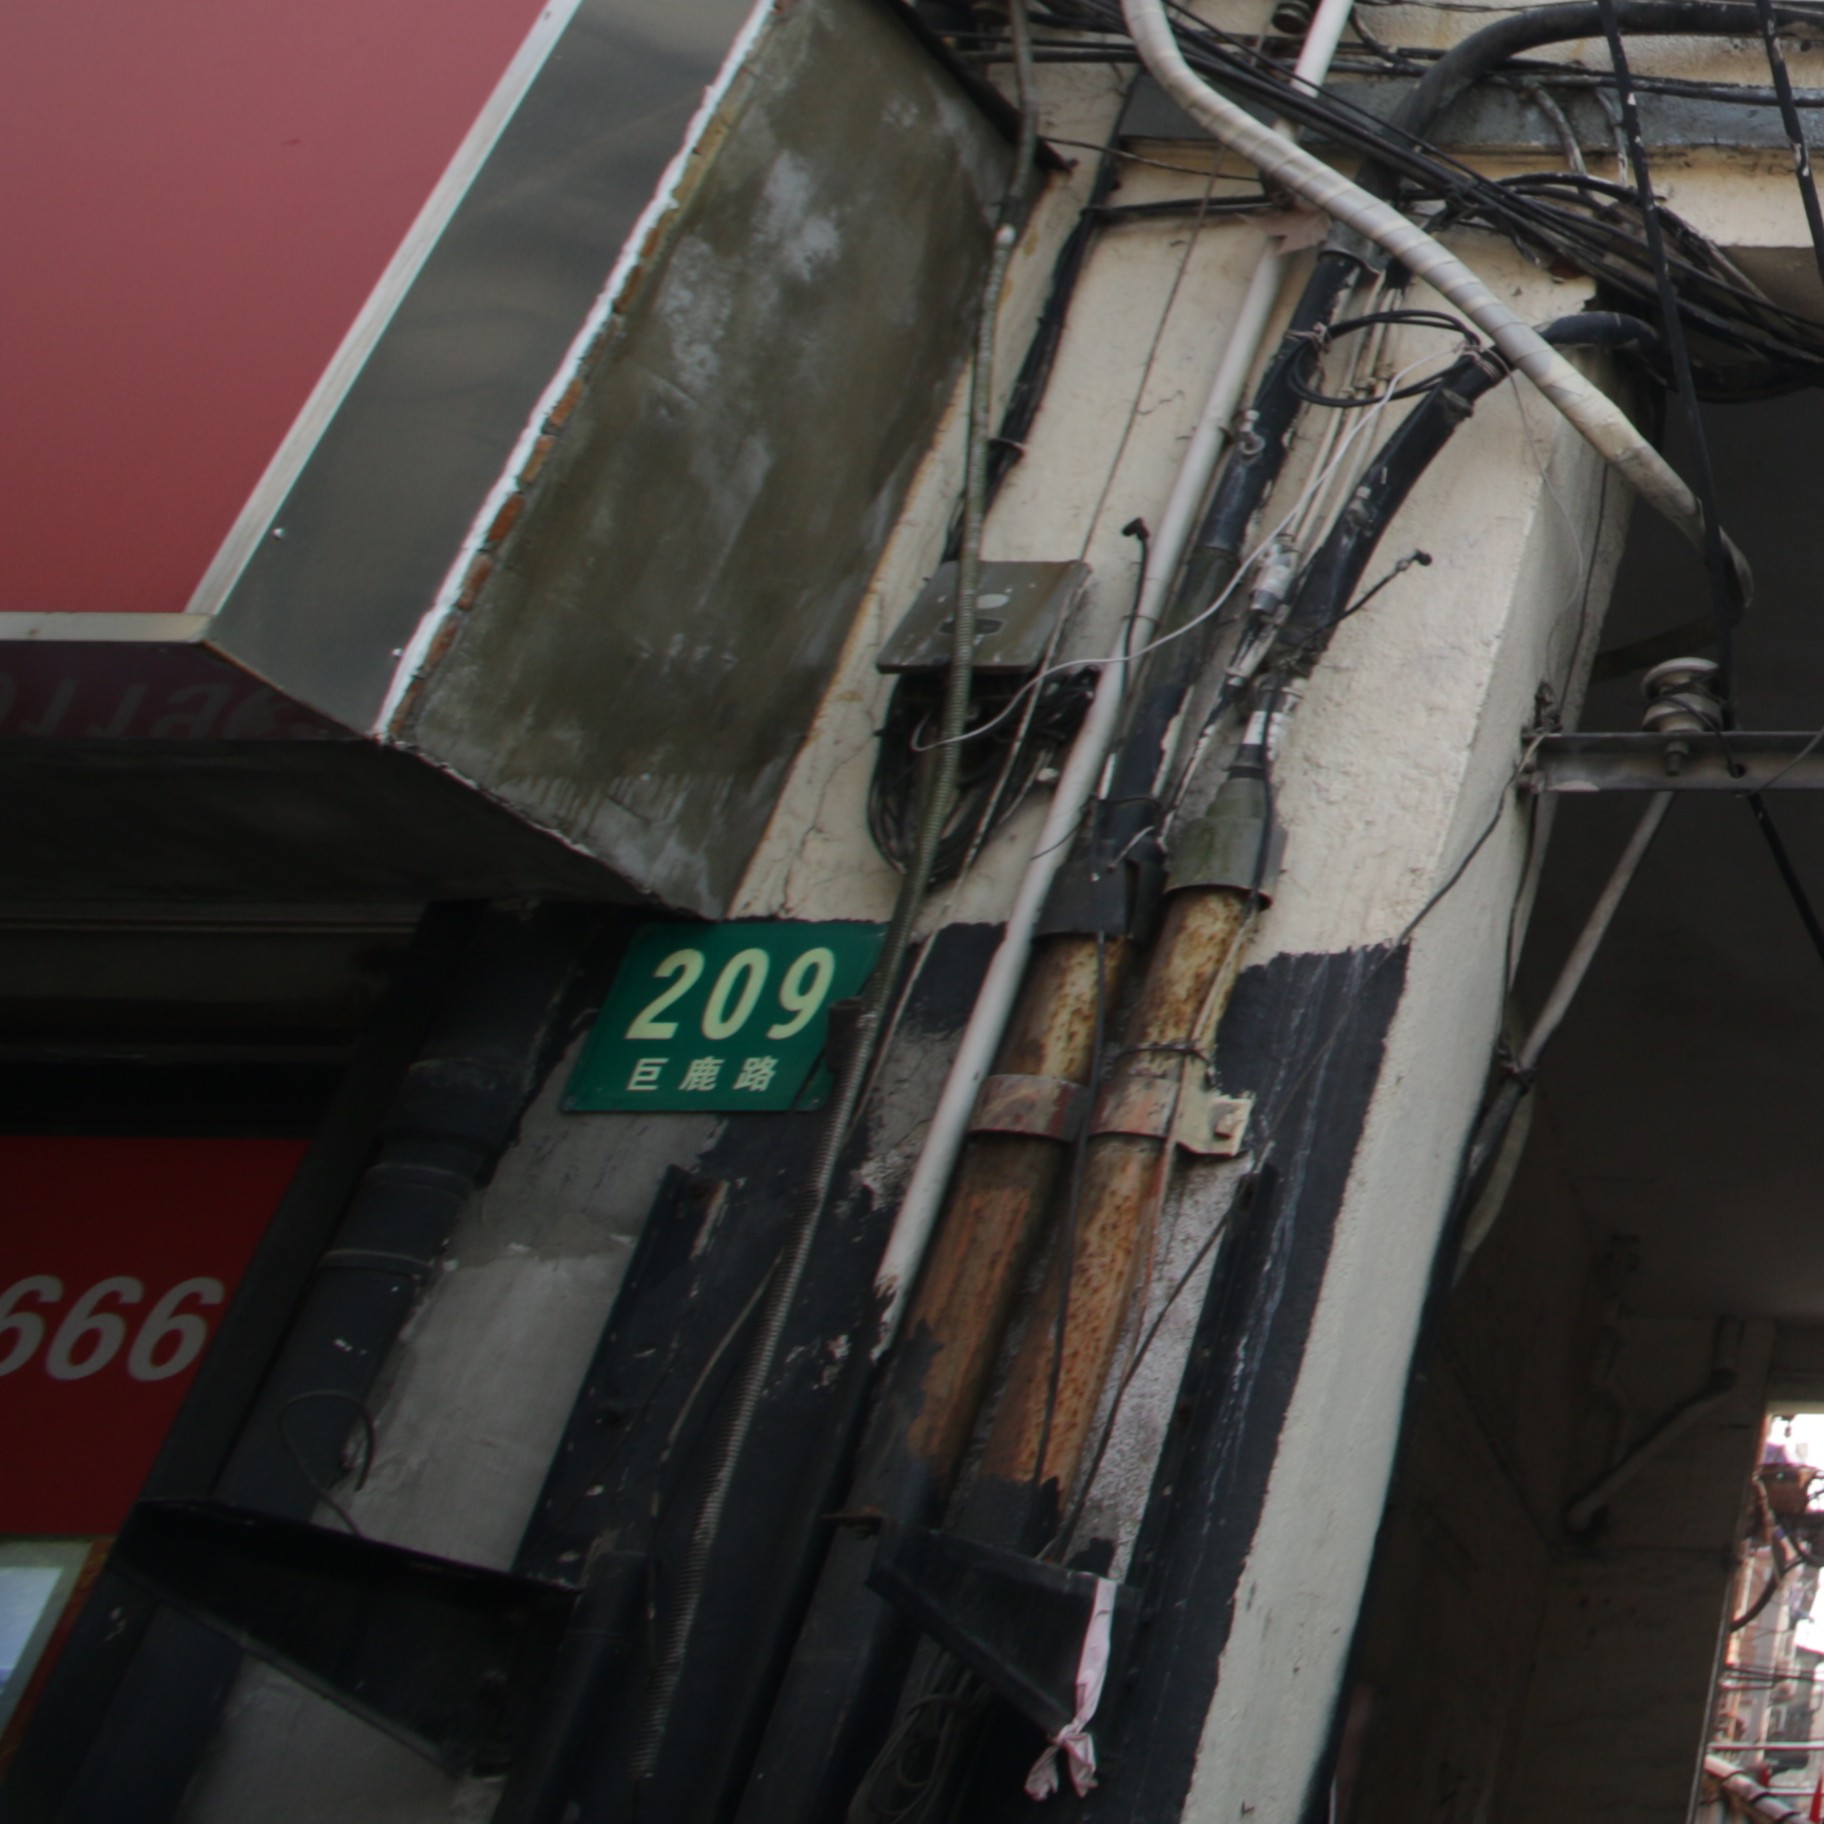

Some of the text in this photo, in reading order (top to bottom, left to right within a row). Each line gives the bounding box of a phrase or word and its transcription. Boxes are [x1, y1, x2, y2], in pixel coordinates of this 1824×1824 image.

[624, 946, 836, 1041] 209
[625, 1055, 779, 1093] 巨鹿路
